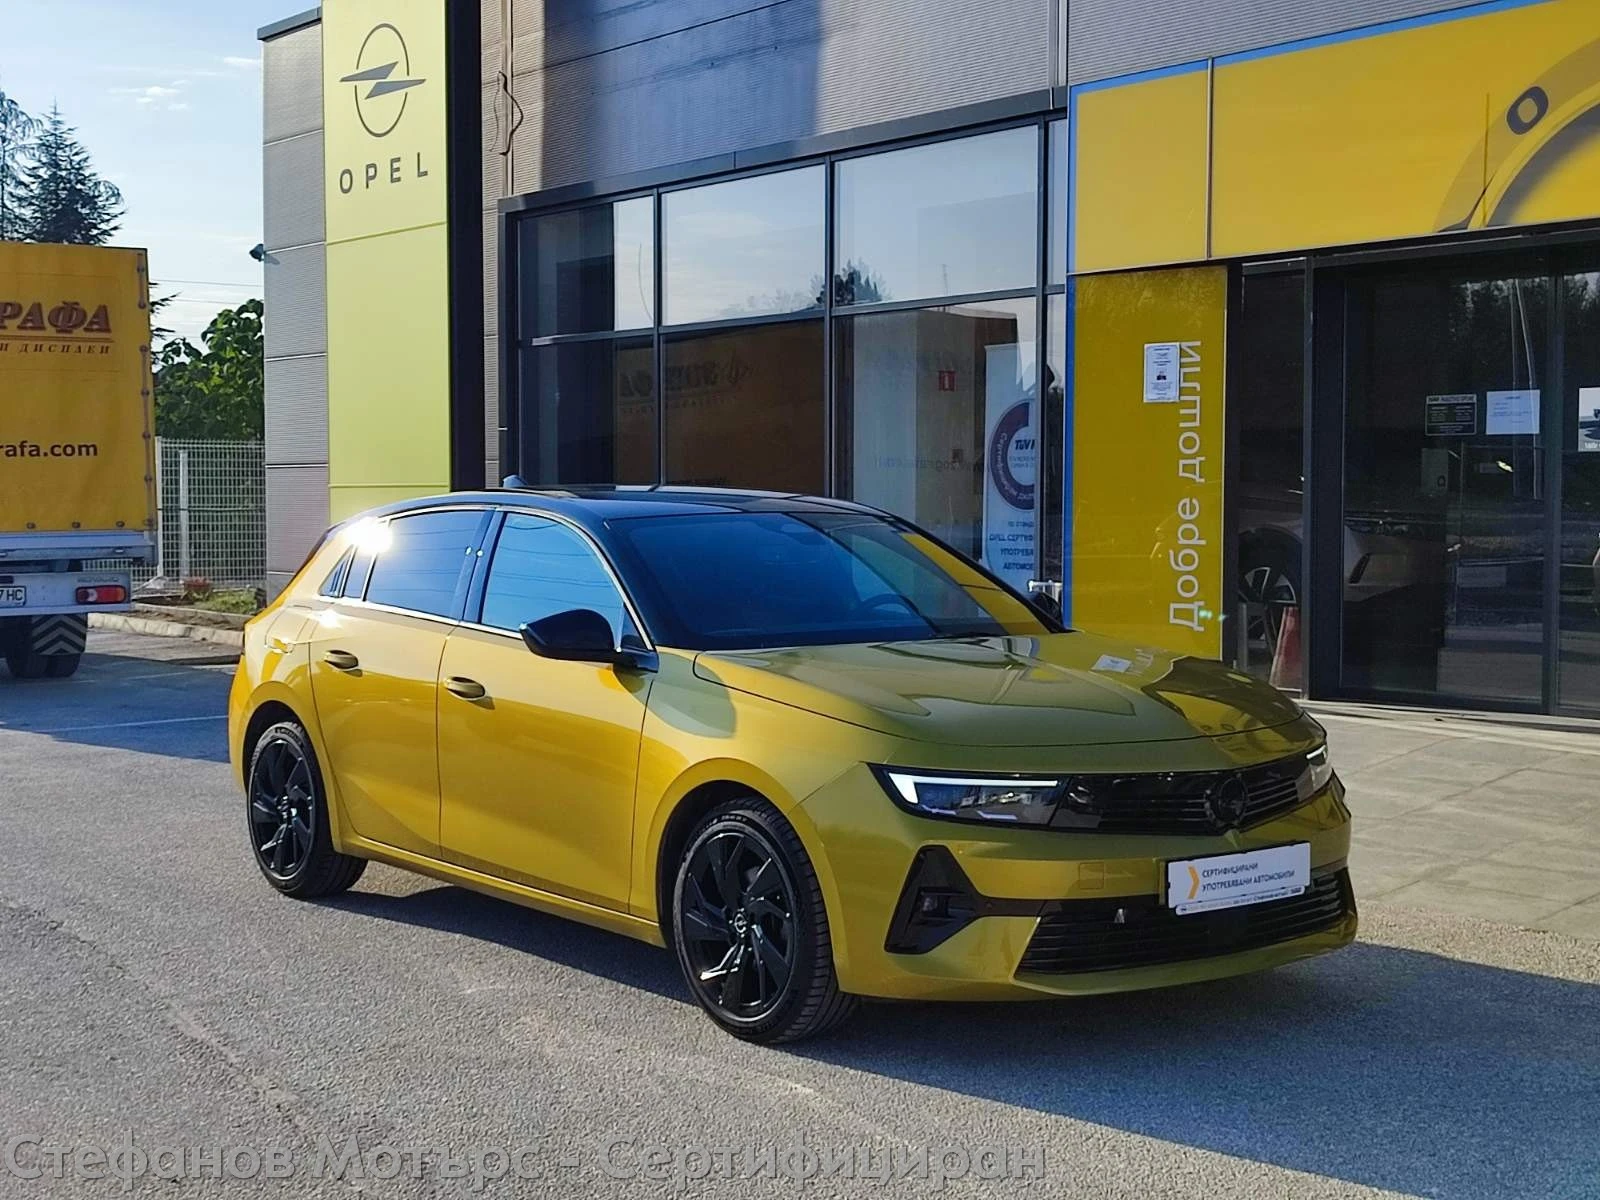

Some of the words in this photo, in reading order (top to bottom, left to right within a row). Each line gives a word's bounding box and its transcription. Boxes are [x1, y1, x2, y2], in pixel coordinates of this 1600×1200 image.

[339, 152, 428, 194] OPEL
[1178, 340, 1206, 483] дошли
[1169, 497, 1206, 632] Добре
[1202, 863, 1258, 878] СЕРТИФИЦИРАНИ
